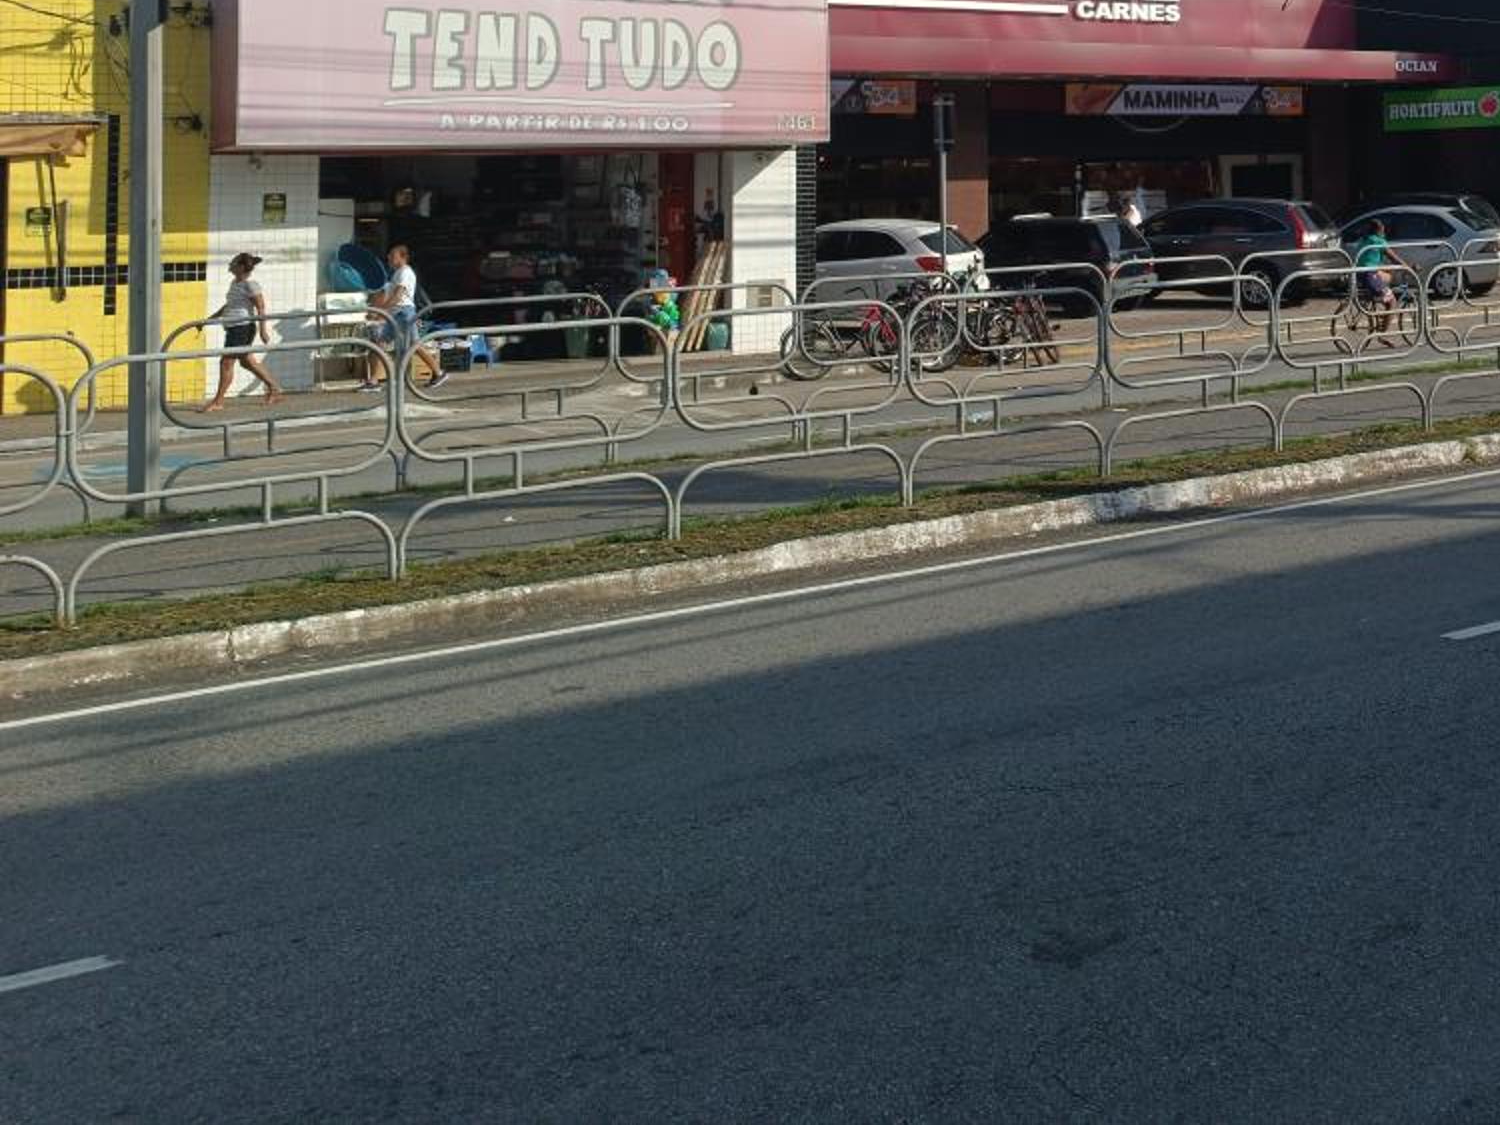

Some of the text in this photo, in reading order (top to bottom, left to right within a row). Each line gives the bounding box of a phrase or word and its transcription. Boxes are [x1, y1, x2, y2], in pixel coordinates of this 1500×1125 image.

[1076, 0, 1181, 23] CARNES
[384, 6, 743, 92] TEND TUDO
[1395, 60, 1438, 73] OCIAN
[1124, 90, 1220, 111] MAMINHA
[1389, 100, 1475, 120] HORTIFRUTI
[440, 114, 455, 130] A
[569, 115, 593, 130] DE
